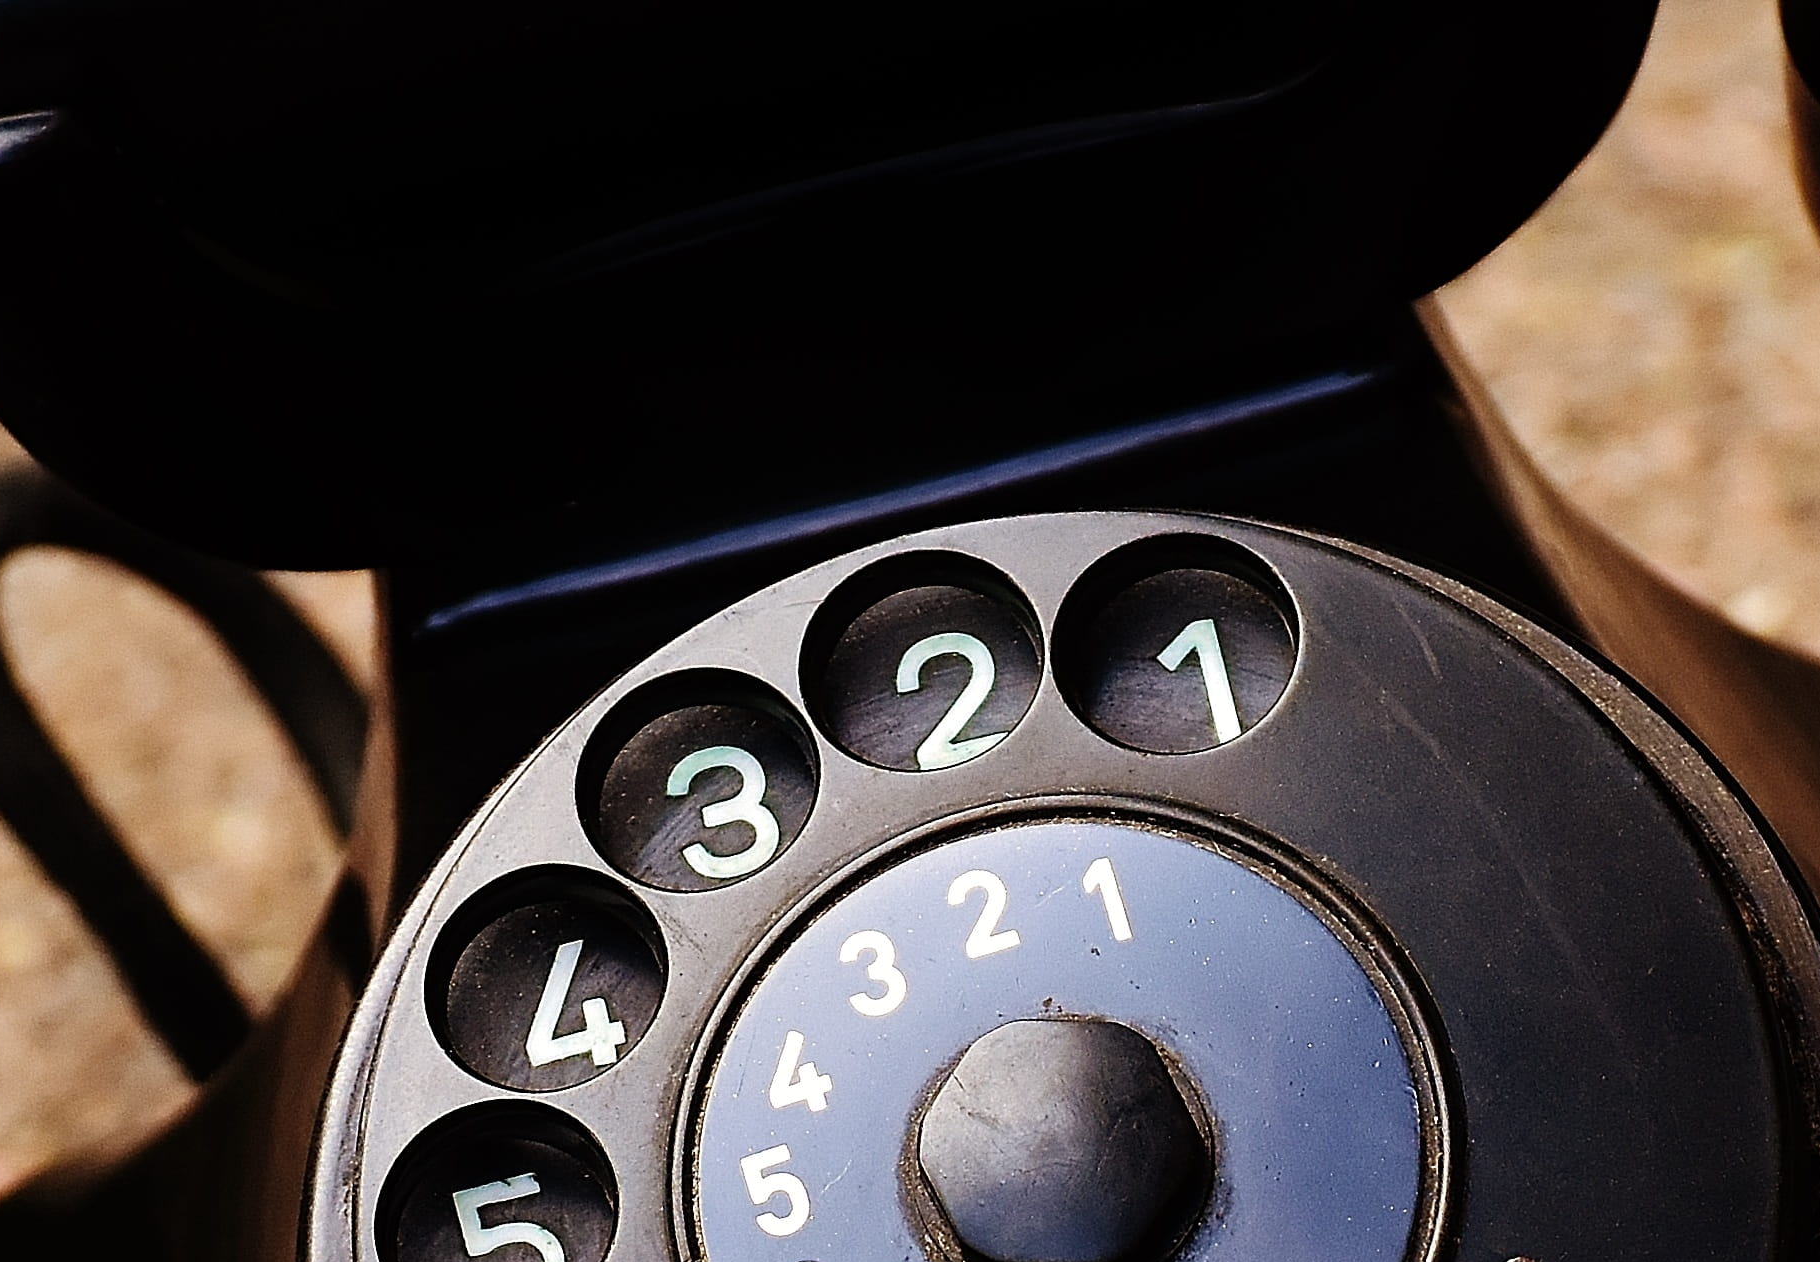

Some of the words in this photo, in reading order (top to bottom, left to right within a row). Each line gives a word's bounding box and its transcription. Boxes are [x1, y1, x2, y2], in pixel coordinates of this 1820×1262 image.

[894, 631, 1009, 772] 2
[1155, 617, 1243, 745] 1
[665, 744, 781, 880] 3
[946, 869, 1022, 960] 2
[1081, 856, 1133, 943] 1
[524, 938, 627, 1069] 4
[837, 929, 908, 1018] 3
[768, 1029, 834, 1113] 4
[739, 1143, 811, 1237] 5
